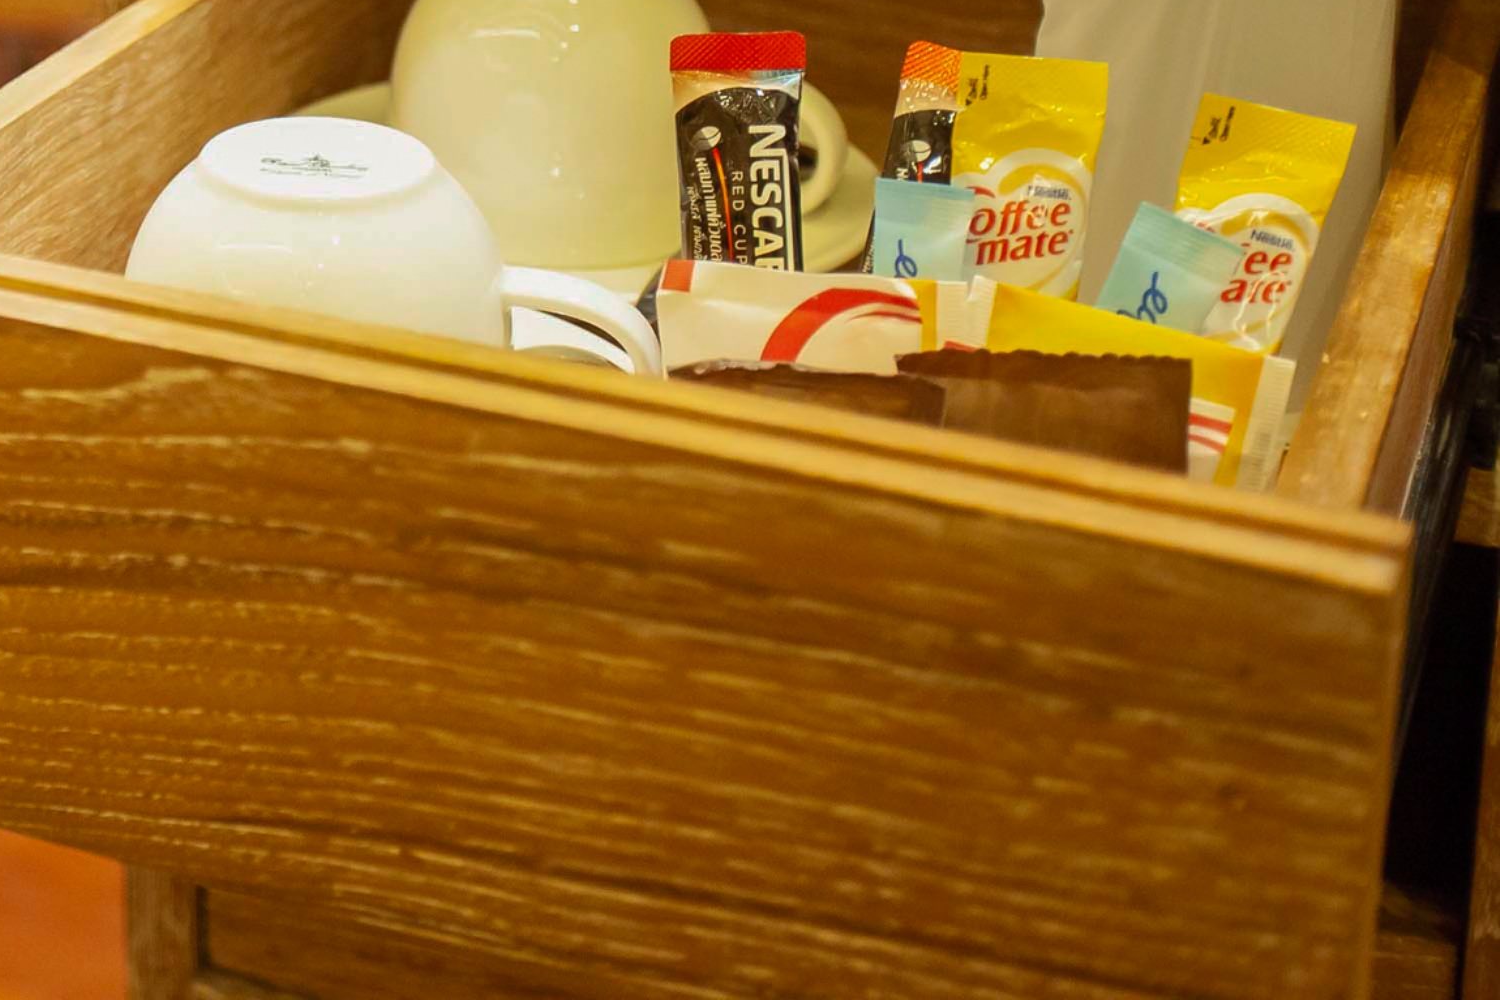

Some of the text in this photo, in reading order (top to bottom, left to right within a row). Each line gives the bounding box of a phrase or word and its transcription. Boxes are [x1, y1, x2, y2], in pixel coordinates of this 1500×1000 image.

[731, 170, 748, 265] RED CUP
[748, 124, 794, 271] NESCAF
[975, 230, 1072, 266] mate
[1220, 278, 1292, 304] ate
